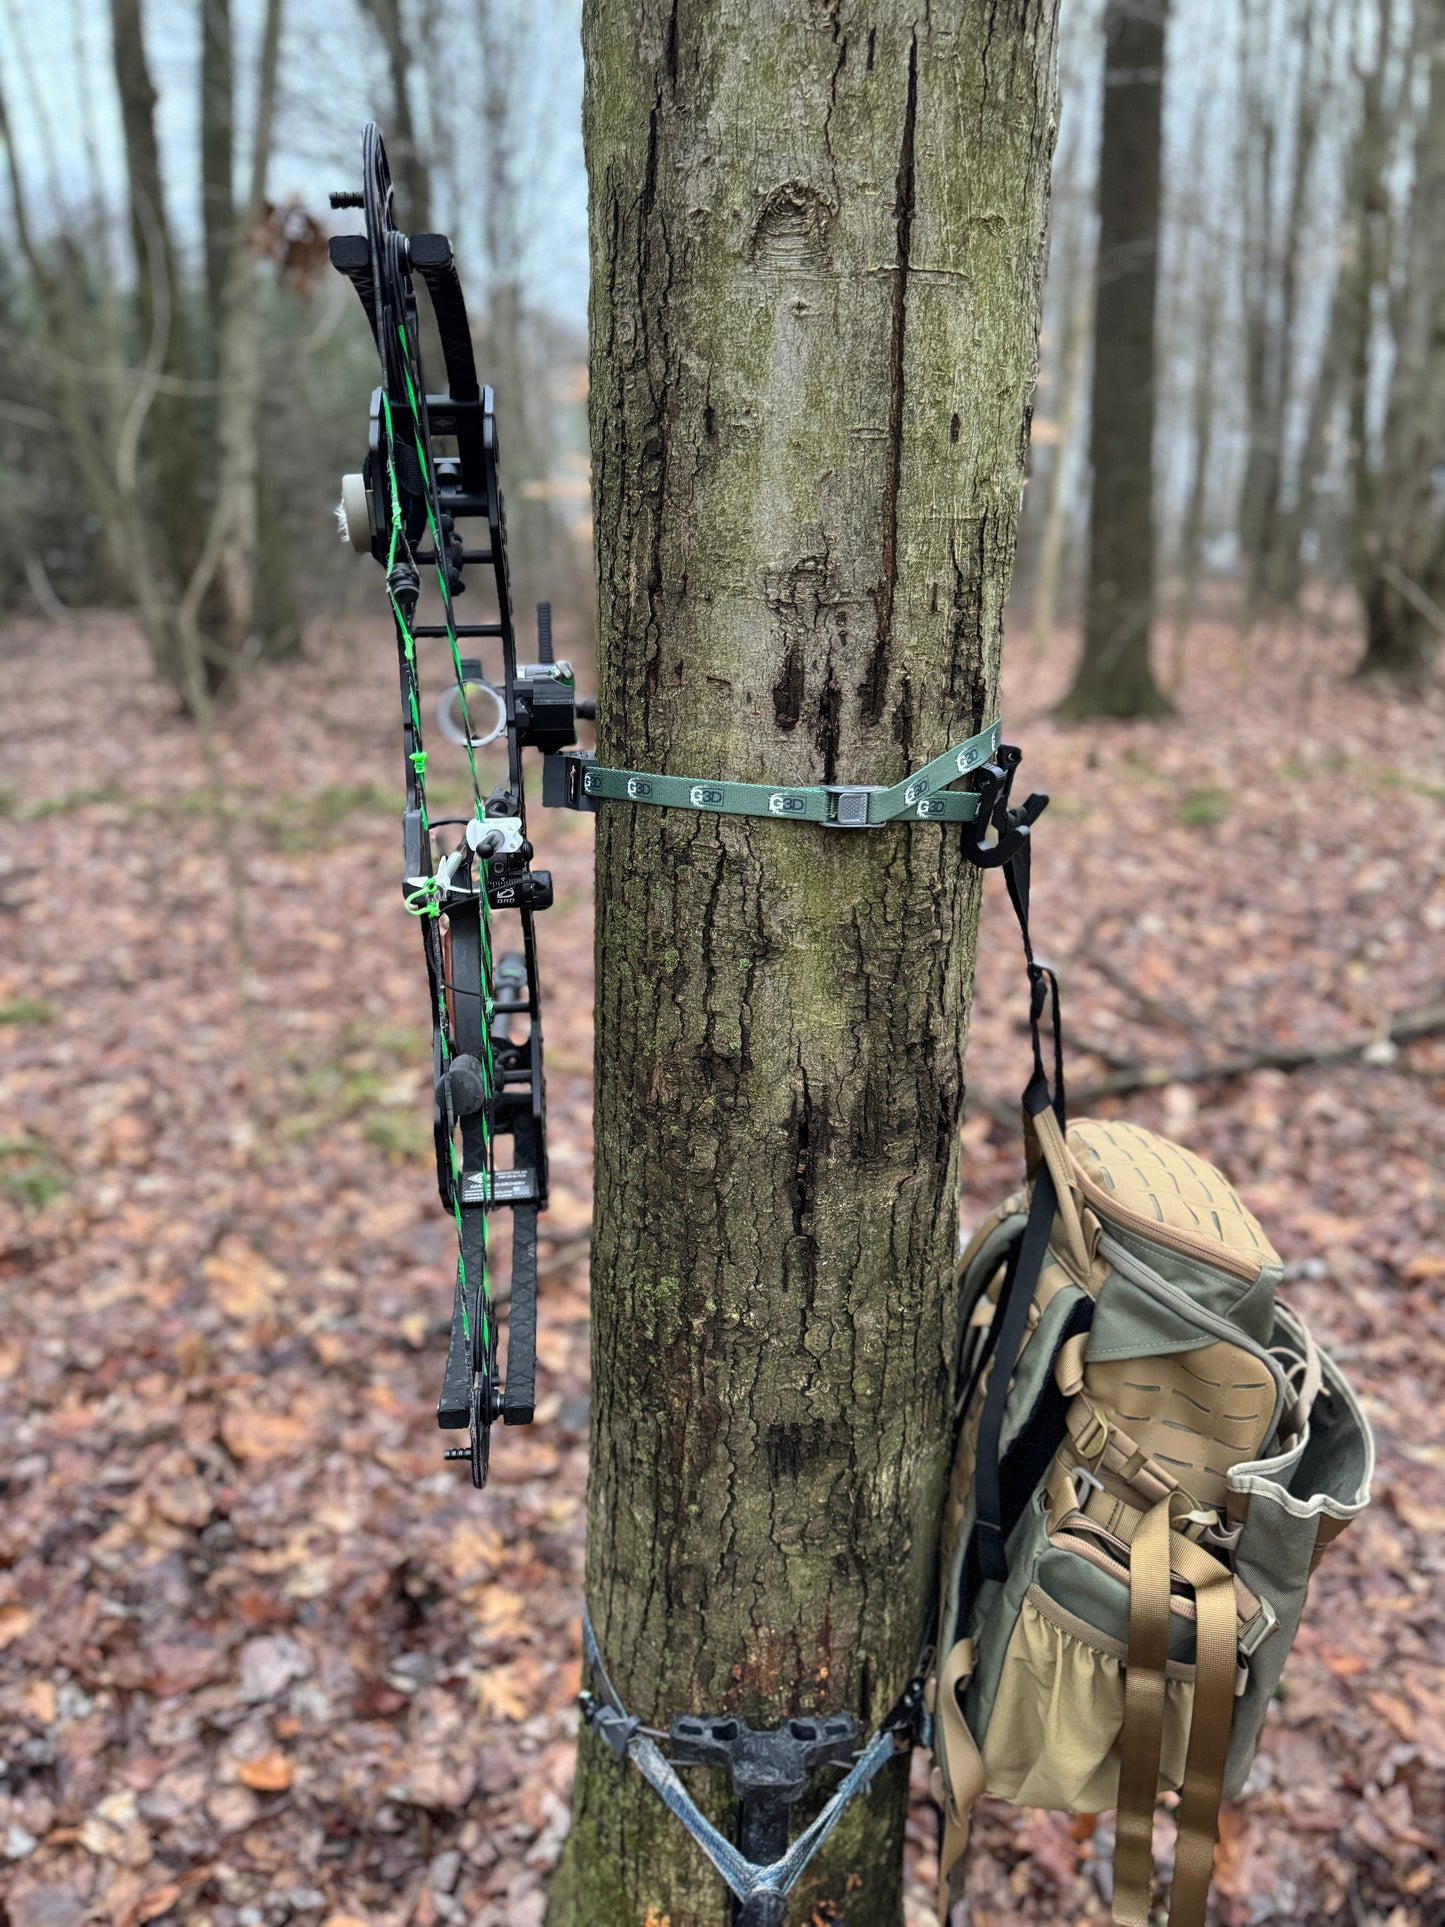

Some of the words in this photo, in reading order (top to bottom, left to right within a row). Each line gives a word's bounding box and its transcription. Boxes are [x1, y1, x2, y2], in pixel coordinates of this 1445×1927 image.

[584, 774, 602, 789] G3D
[628, 779, 652, 796] G3D
[690, 787, 723, 805] G3D
[769, 796, 806, 814] G3D
[905, 778, 929, 802] G3D
[957, 747, 980, 771] G3D
[918, 799, 946, 815] G3D
